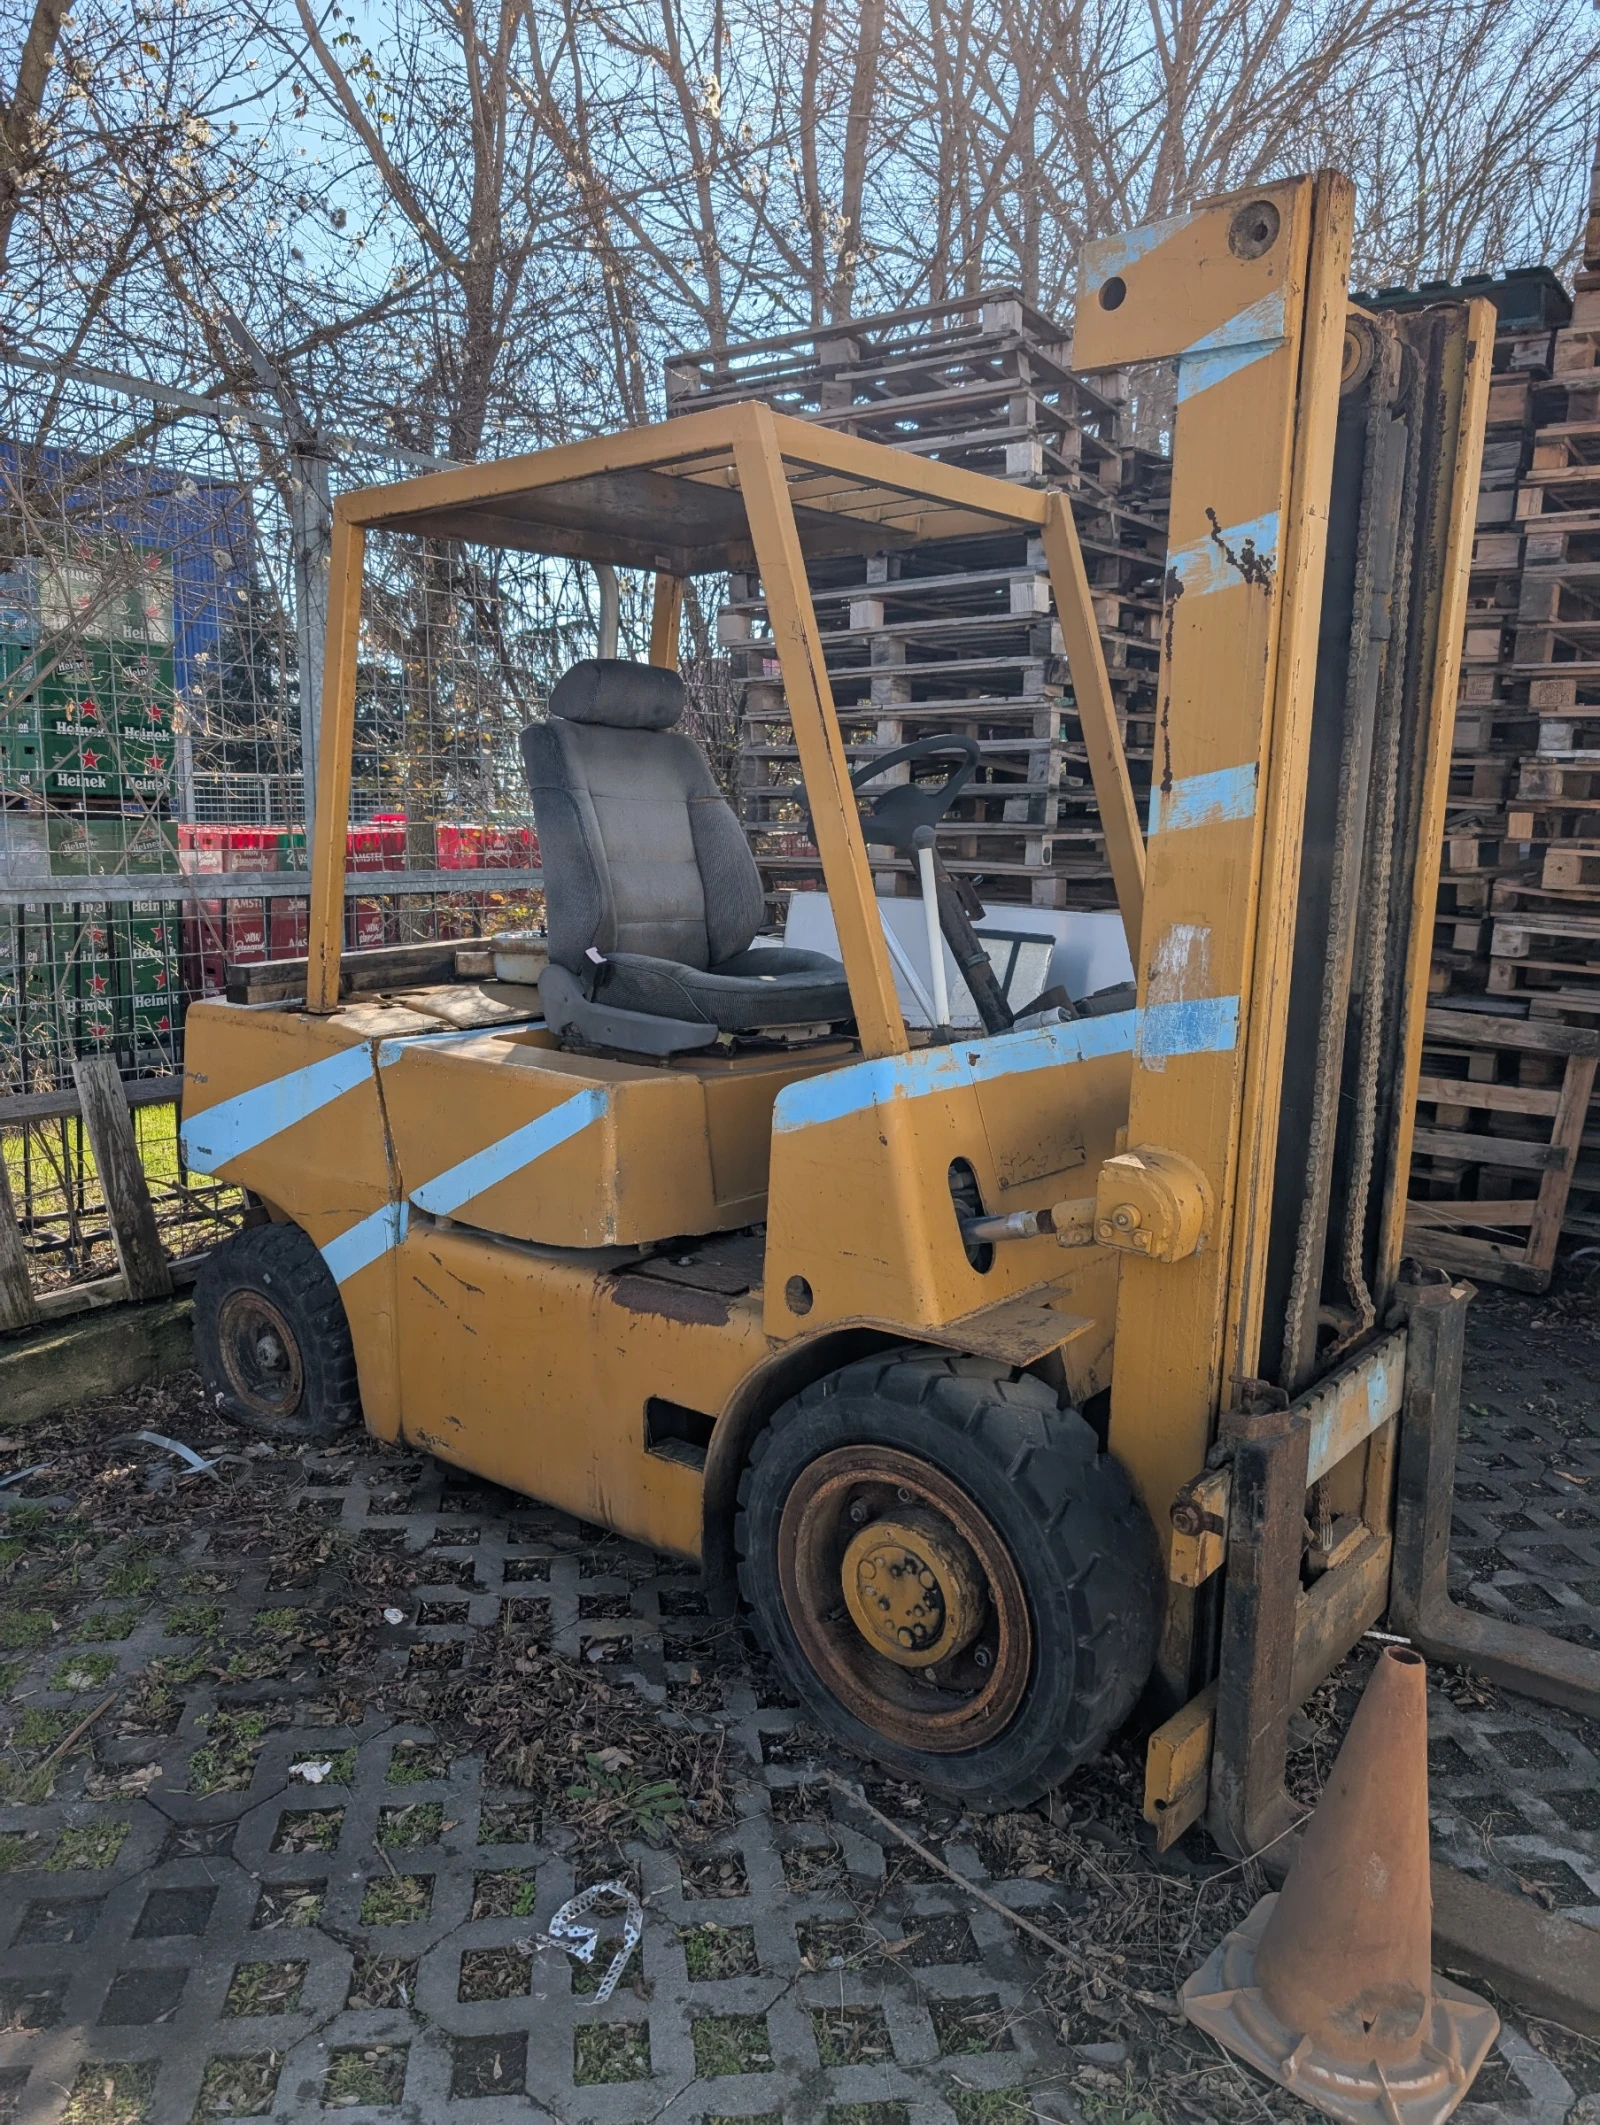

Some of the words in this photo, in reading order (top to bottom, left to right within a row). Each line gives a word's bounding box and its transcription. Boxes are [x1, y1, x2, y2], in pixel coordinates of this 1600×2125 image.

[124, 726, 170, 742] Heinek
[57, 773, 106, 788] Heinek
[233, 898, 262, 909] AMST
